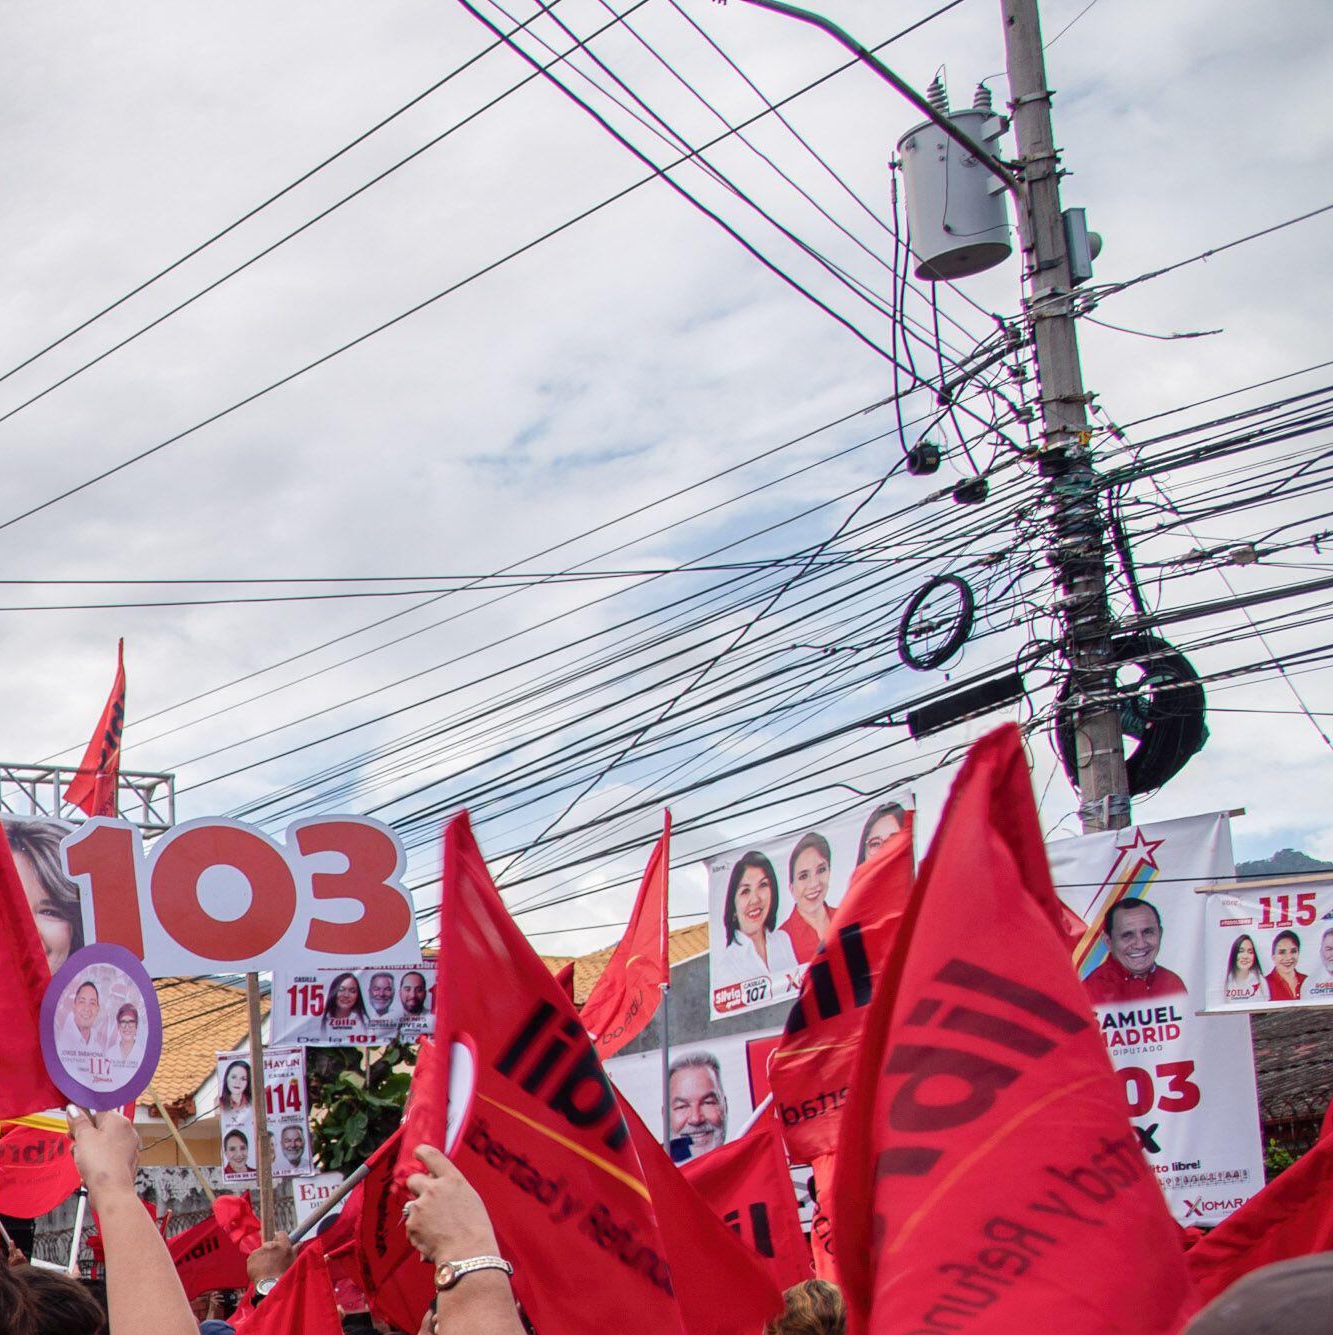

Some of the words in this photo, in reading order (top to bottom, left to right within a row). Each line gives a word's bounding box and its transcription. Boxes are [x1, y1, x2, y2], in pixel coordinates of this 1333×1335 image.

[67, 822, 414, 962] 103
[1258, 893, 1317, 927] 115
[287, 985, 324, 1016] 115
[745, 985, 767, 1004] 107
[1096, 1005, 1182, 1030] AMUEL
[347, 1034, 376, 1043] 101
[1113, 1045, 1163, 1056] DIPUTADO
[90, 1058, 111, 1075] 117
[264, 1078, 301, 1114] 114
[1172, 1160, 1201, 1172] libre!
[300, 1183, 340, 1202] En
[1183, 1197, 1249, 1218] XIOMAR
